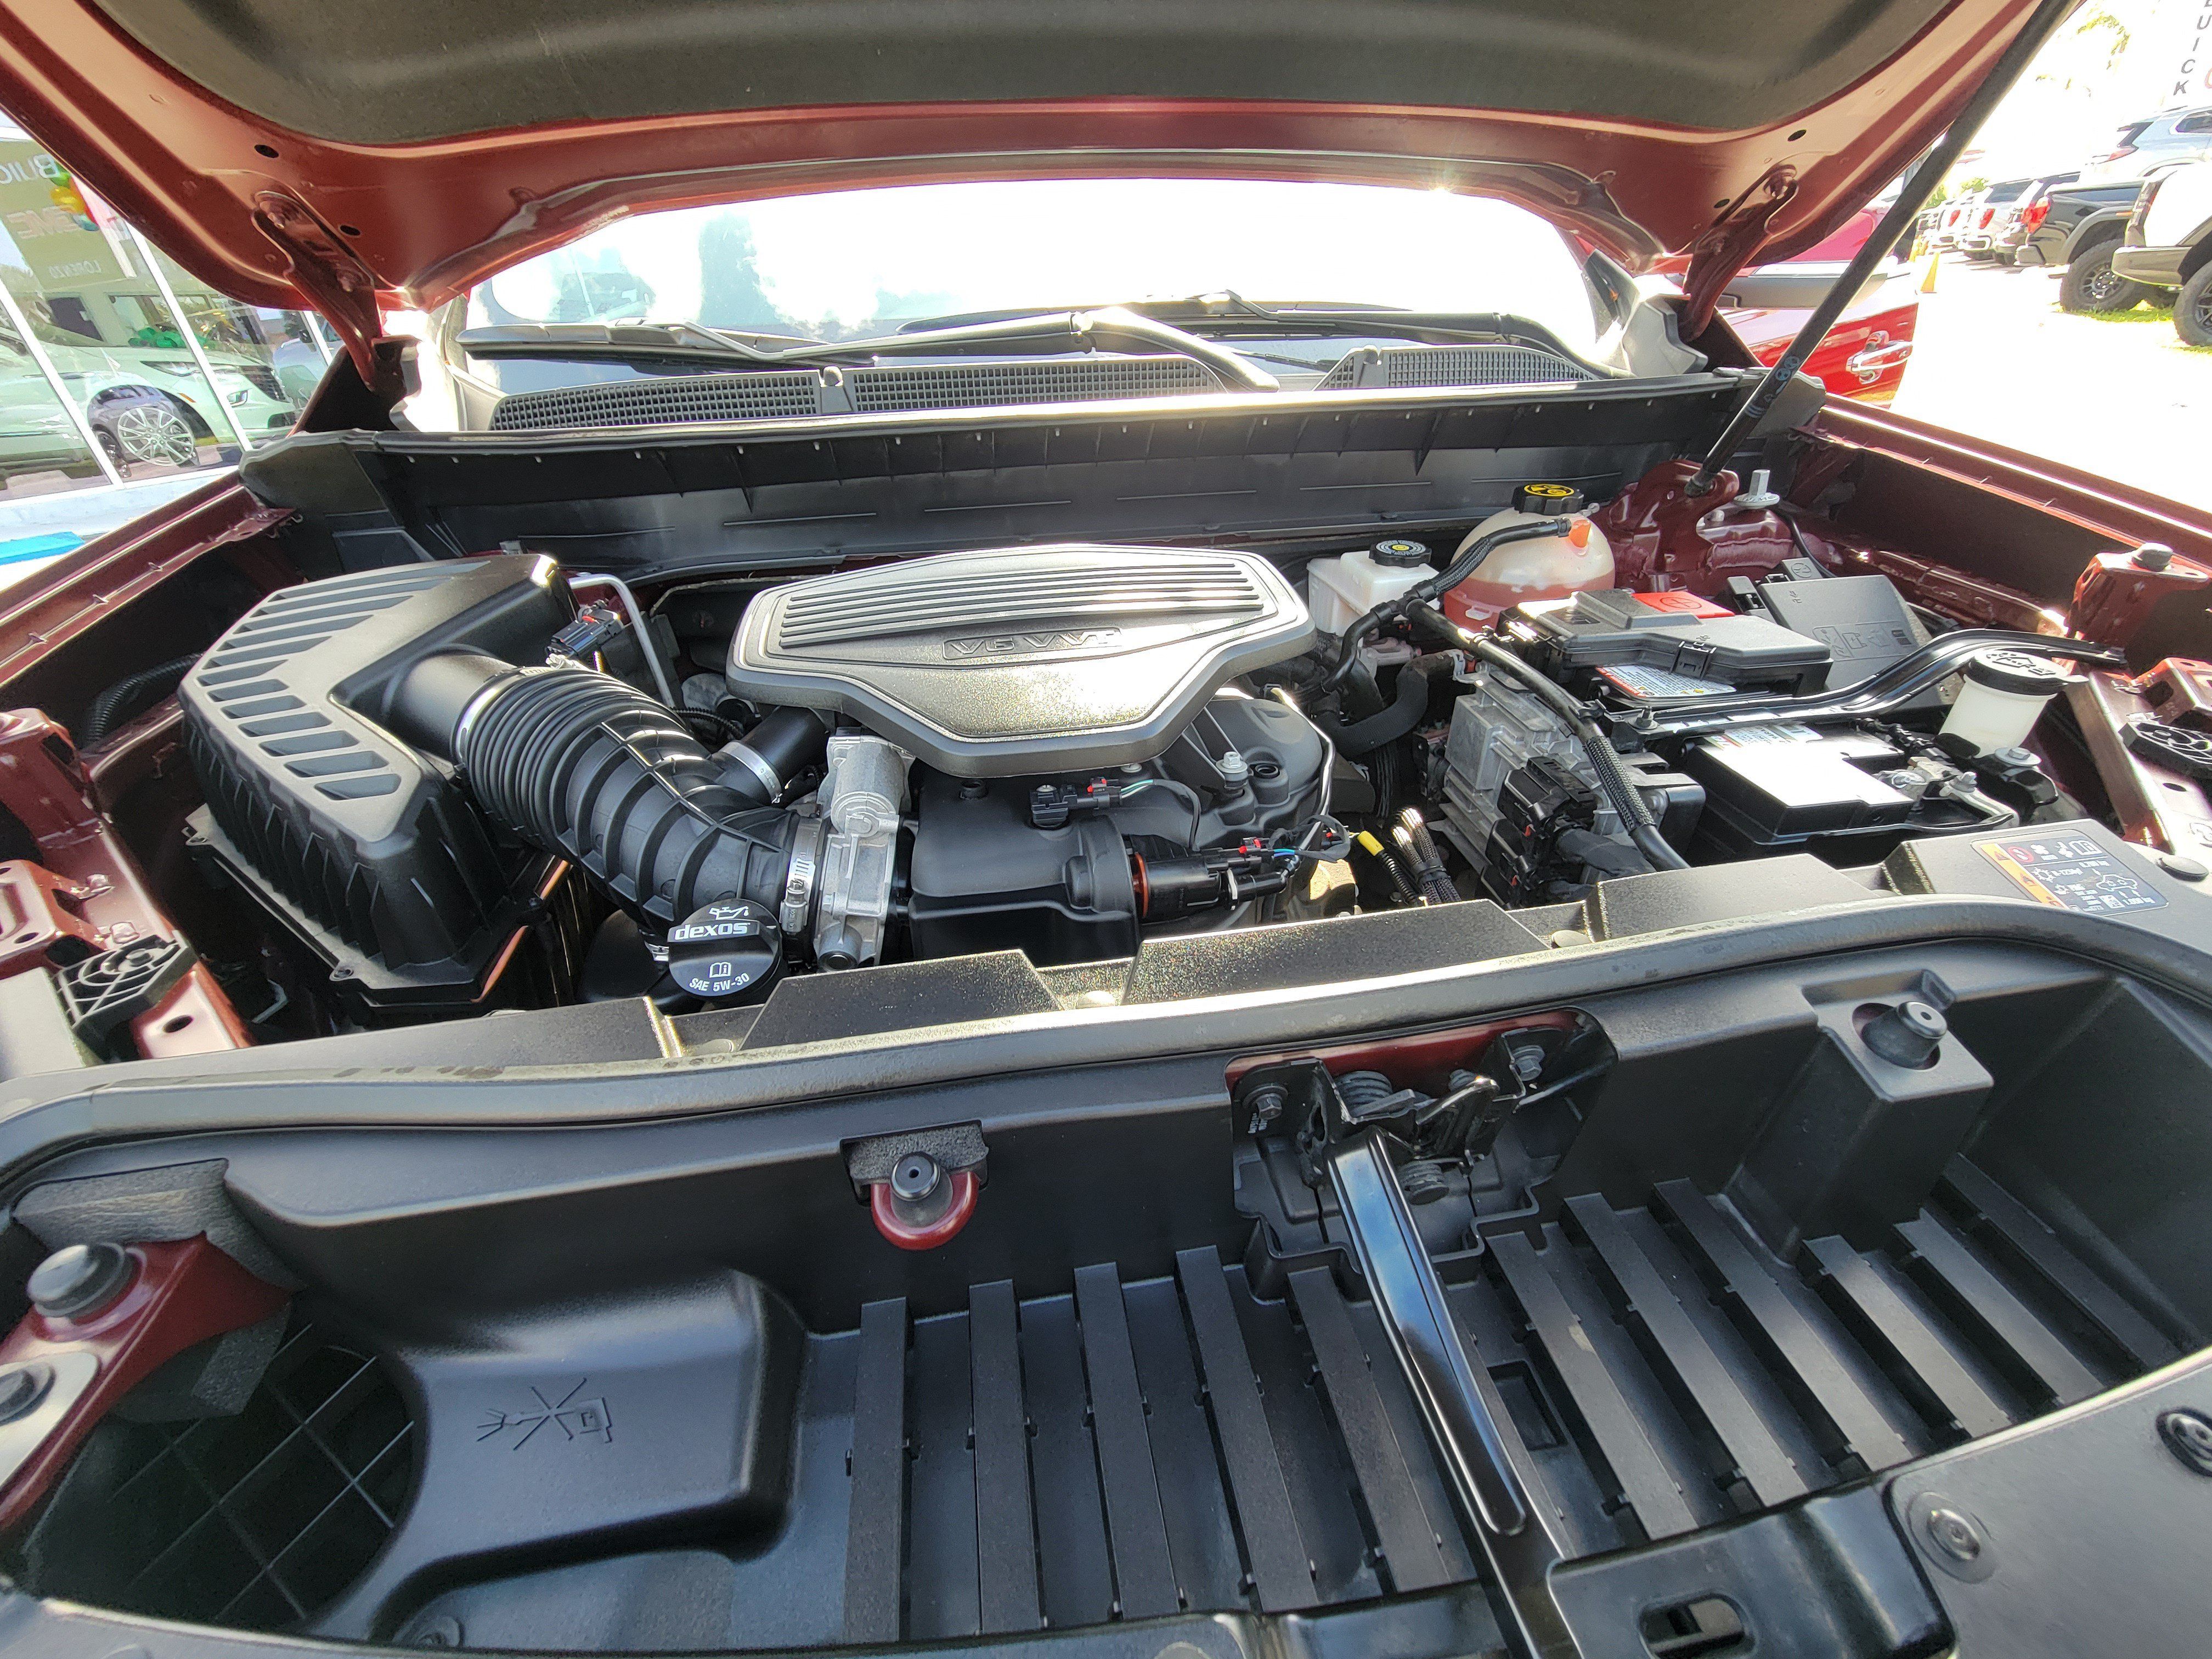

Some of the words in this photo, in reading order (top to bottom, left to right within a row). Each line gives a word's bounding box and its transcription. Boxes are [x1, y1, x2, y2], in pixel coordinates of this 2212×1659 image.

[950, 637, 1015, 654] V6
[675, 922, 748, 940] dexos
[689, 978, 709, 991] SAE
[713, 973, 749, 992] 5W-30
